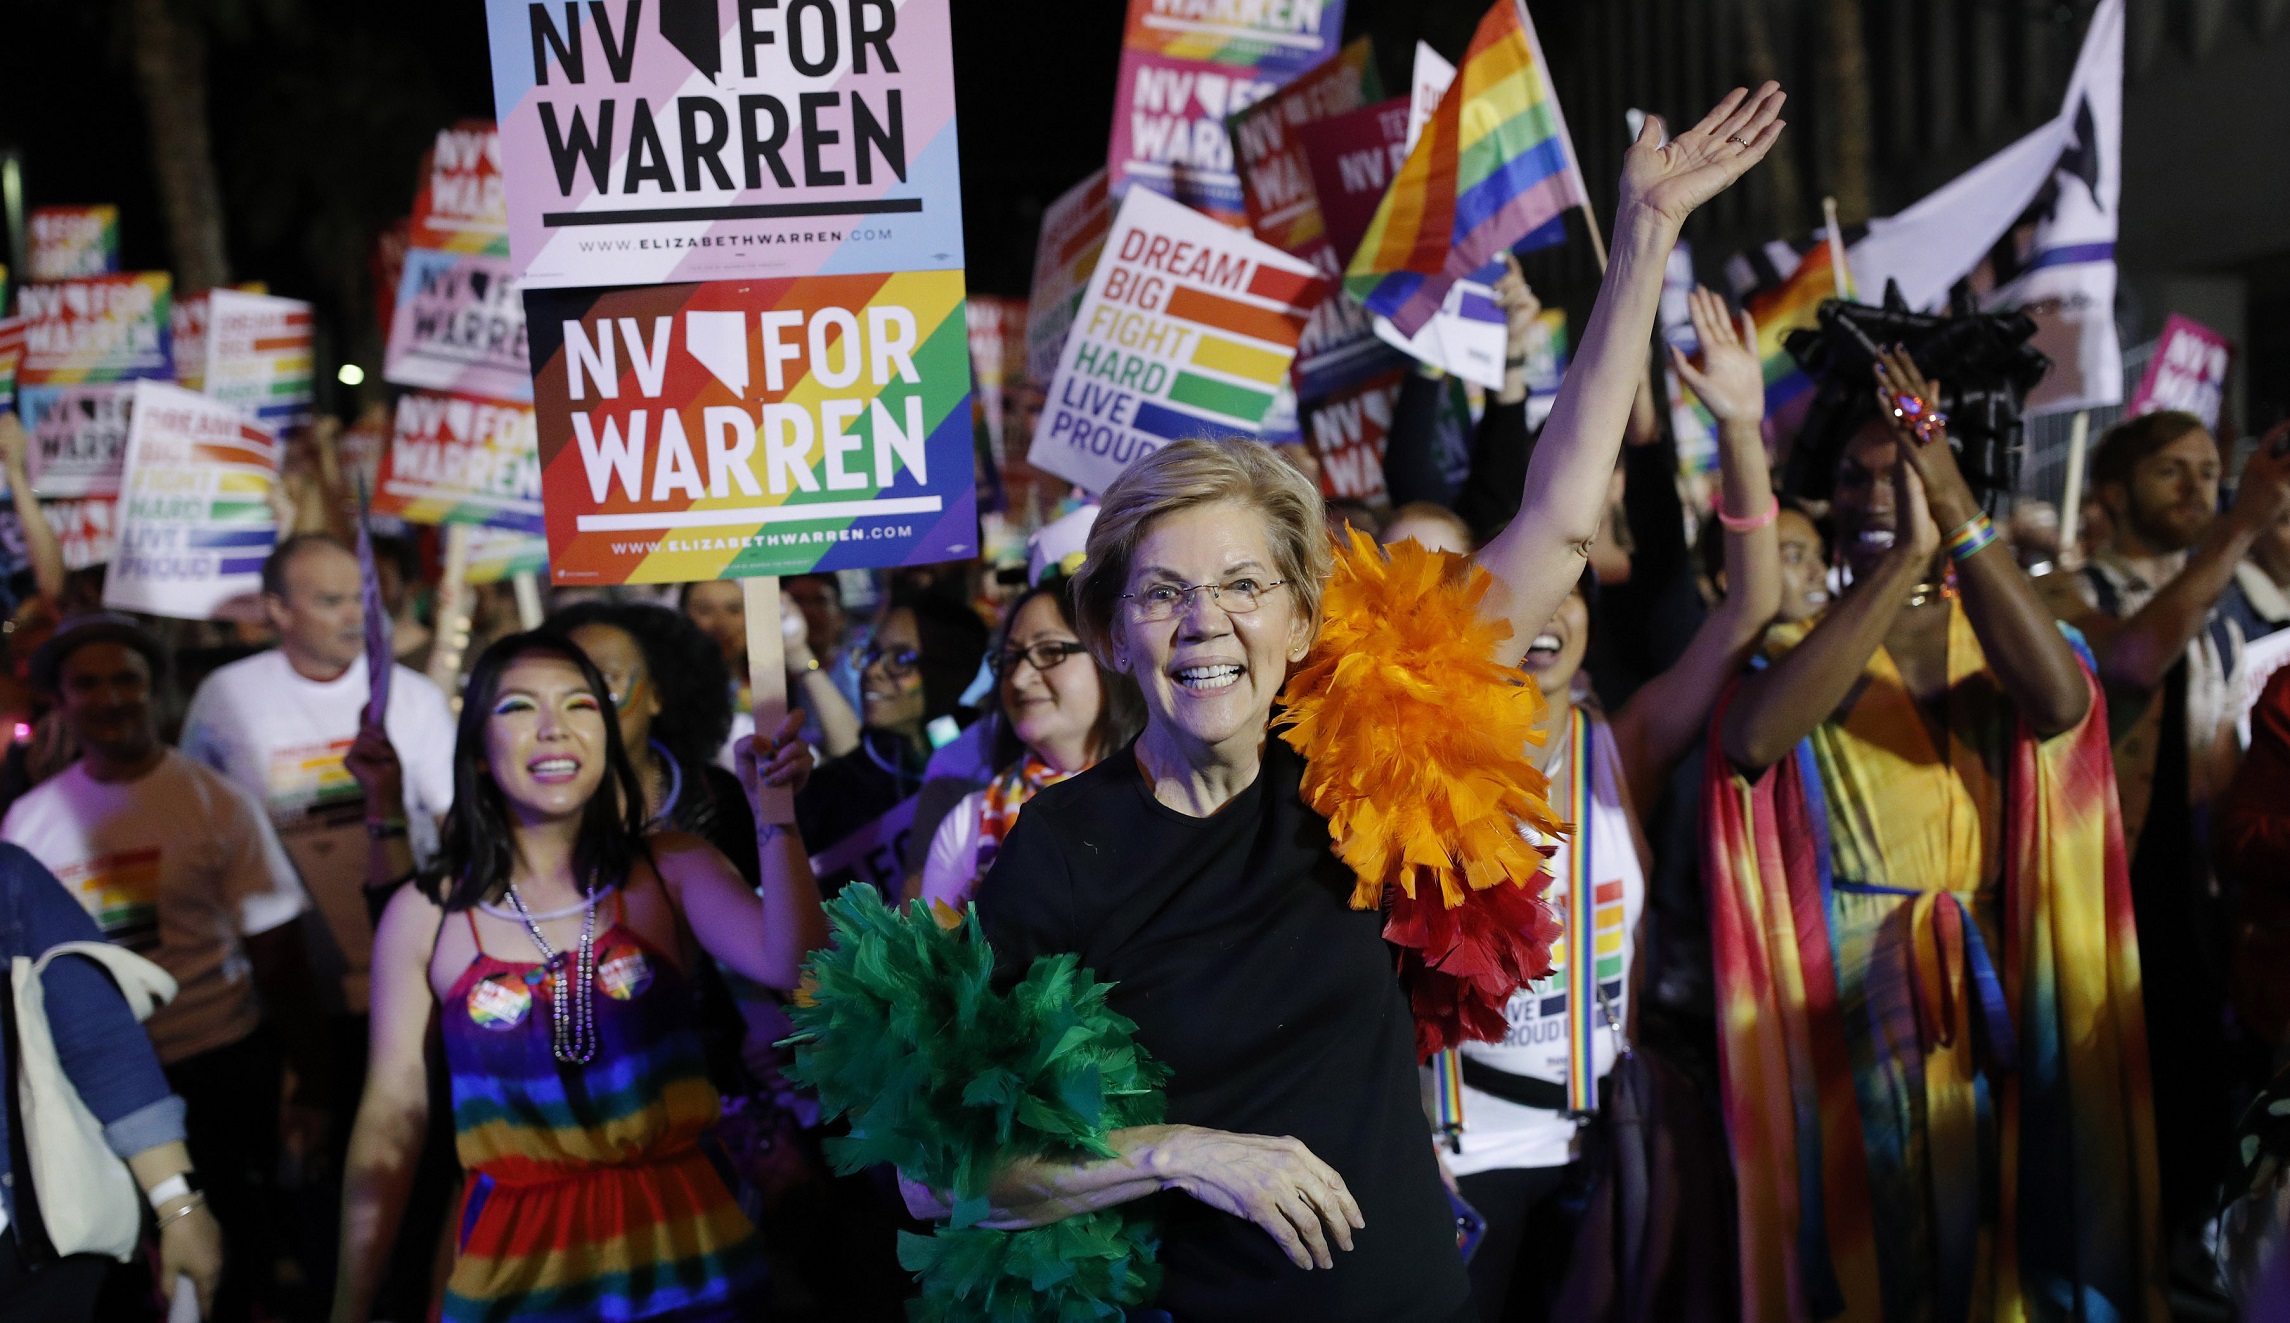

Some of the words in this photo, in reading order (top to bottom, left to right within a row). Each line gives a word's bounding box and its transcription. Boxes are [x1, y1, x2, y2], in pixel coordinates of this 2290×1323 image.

[529, 1, 641, 85] NV
[738, 0, 900, 78] FOR
[1133, 65, 1195, 115] NV
[537, 89, 907, 196] WARREN
[578, 229, 893, 253] WWW.ELIZABETHWARREN.COM
[1119, 228, 1248, 291] DREAM
[1103, 267, 1164, 310] BIG
[562, 316, 673, 400] NV
[760, 305, 922, 392] FOR
[1087, 304, 1192, 359] FIGHT
[1073, 340, 1167, 395] HARD
[1062, 376, 1133, 425] LIVE
[570, 394, 928, 503] WARREN
[610, 525, 913, 555] WWW.ELIZABETHWARREN.COM
